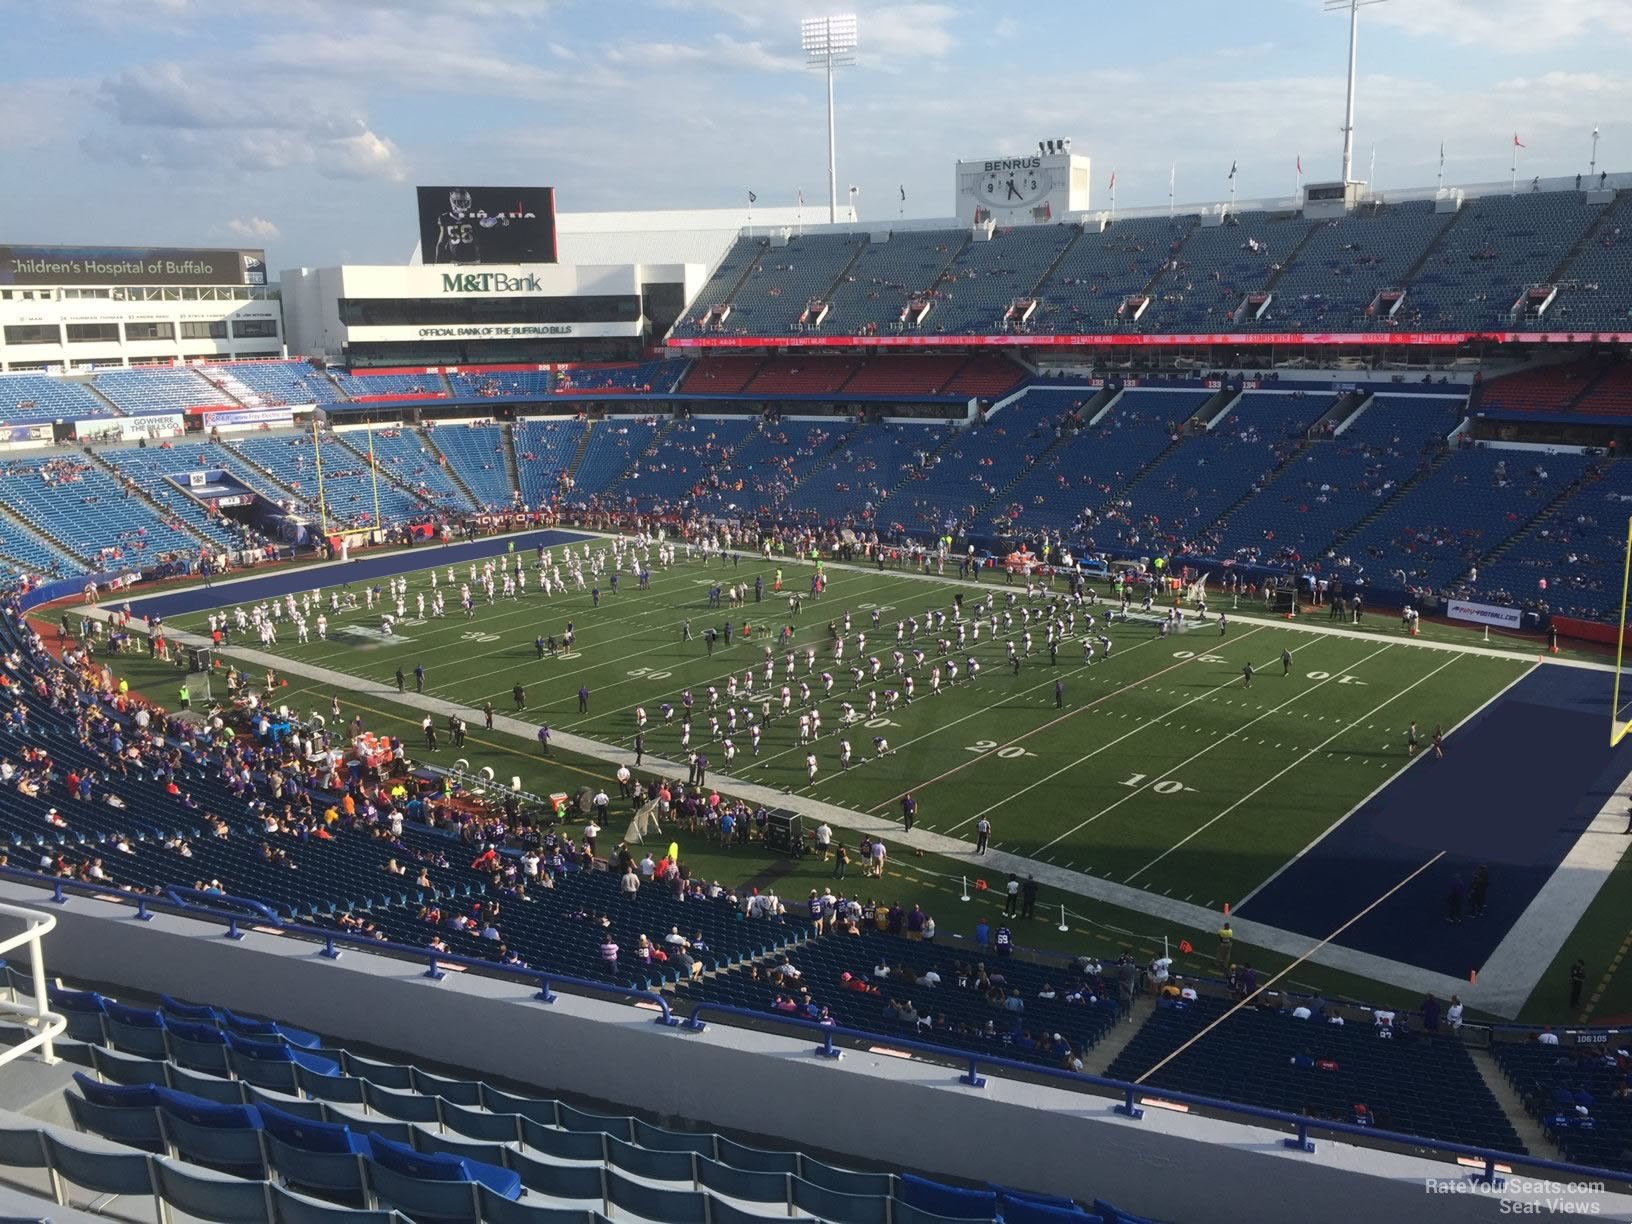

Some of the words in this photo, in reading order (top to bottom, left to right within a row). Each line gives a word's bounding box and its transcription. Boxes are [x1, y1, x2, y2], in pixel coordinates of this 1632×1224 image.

[984, 158, 1041, 171] BENRUS
[987, 183, 994, 193] 9
[1031, 180, 1037, 190] 3
[84, 260, 143, 277] Hospital
[147, 261, 162, 274] of
[166, 261, 213, 274] Buffalo
[441, 272, 494, 293] M&T
[494, 272, 543, 292] Bank
[418, 327, 456, 337] OFFICIAL
[457, 327, 480, 336] BANK
[481, 327, 494, 335] OF
[495, 327, 511, 335] THE
[512, 326, 549, 335] BUFFALO
[549, 325, 572, 334] BILLS
[1123, 379, 1136, 387] 133
[1208, 380, 1221, 388] 133
[146, 416, 174, 424] WHERE
[626, 666, 673, 680] 50
[964, 739, 1026, 759] 20
[1117, 772, 1185, 794] 10
[1593, 1035, 1607, 1043] 105
